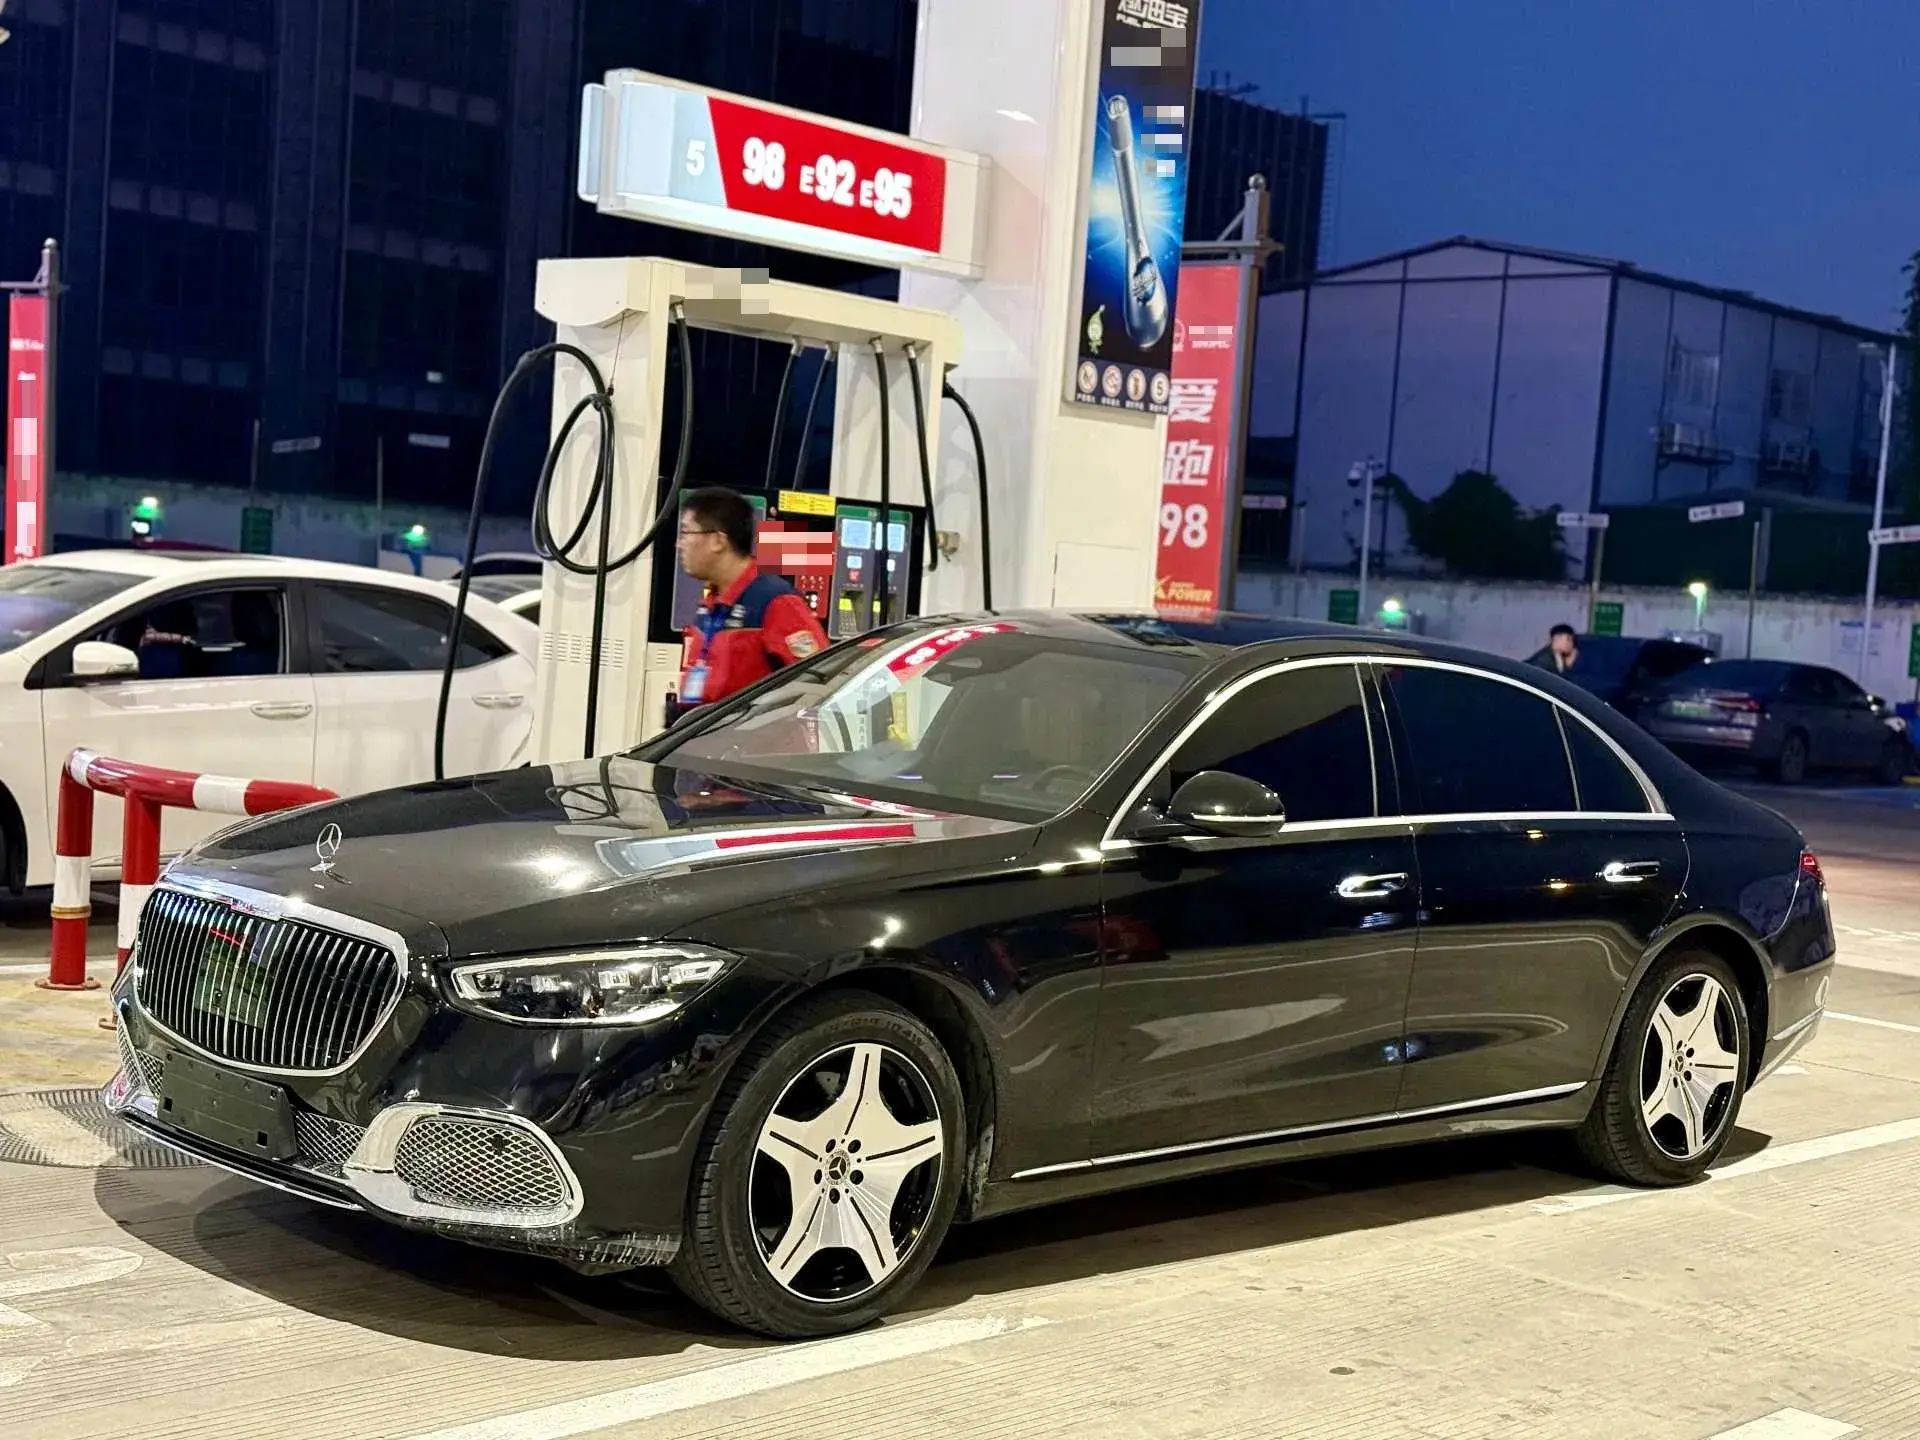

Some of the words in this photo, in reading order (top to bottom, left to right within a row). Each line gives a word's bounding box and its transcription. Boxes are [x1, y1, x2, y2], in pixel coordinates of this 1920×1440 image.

[686, 141, 706, 175] 5
[743, 137, 785, 189] 98
[800, 155, 856, 206] E92
[860, 168, 911, 218] E95
